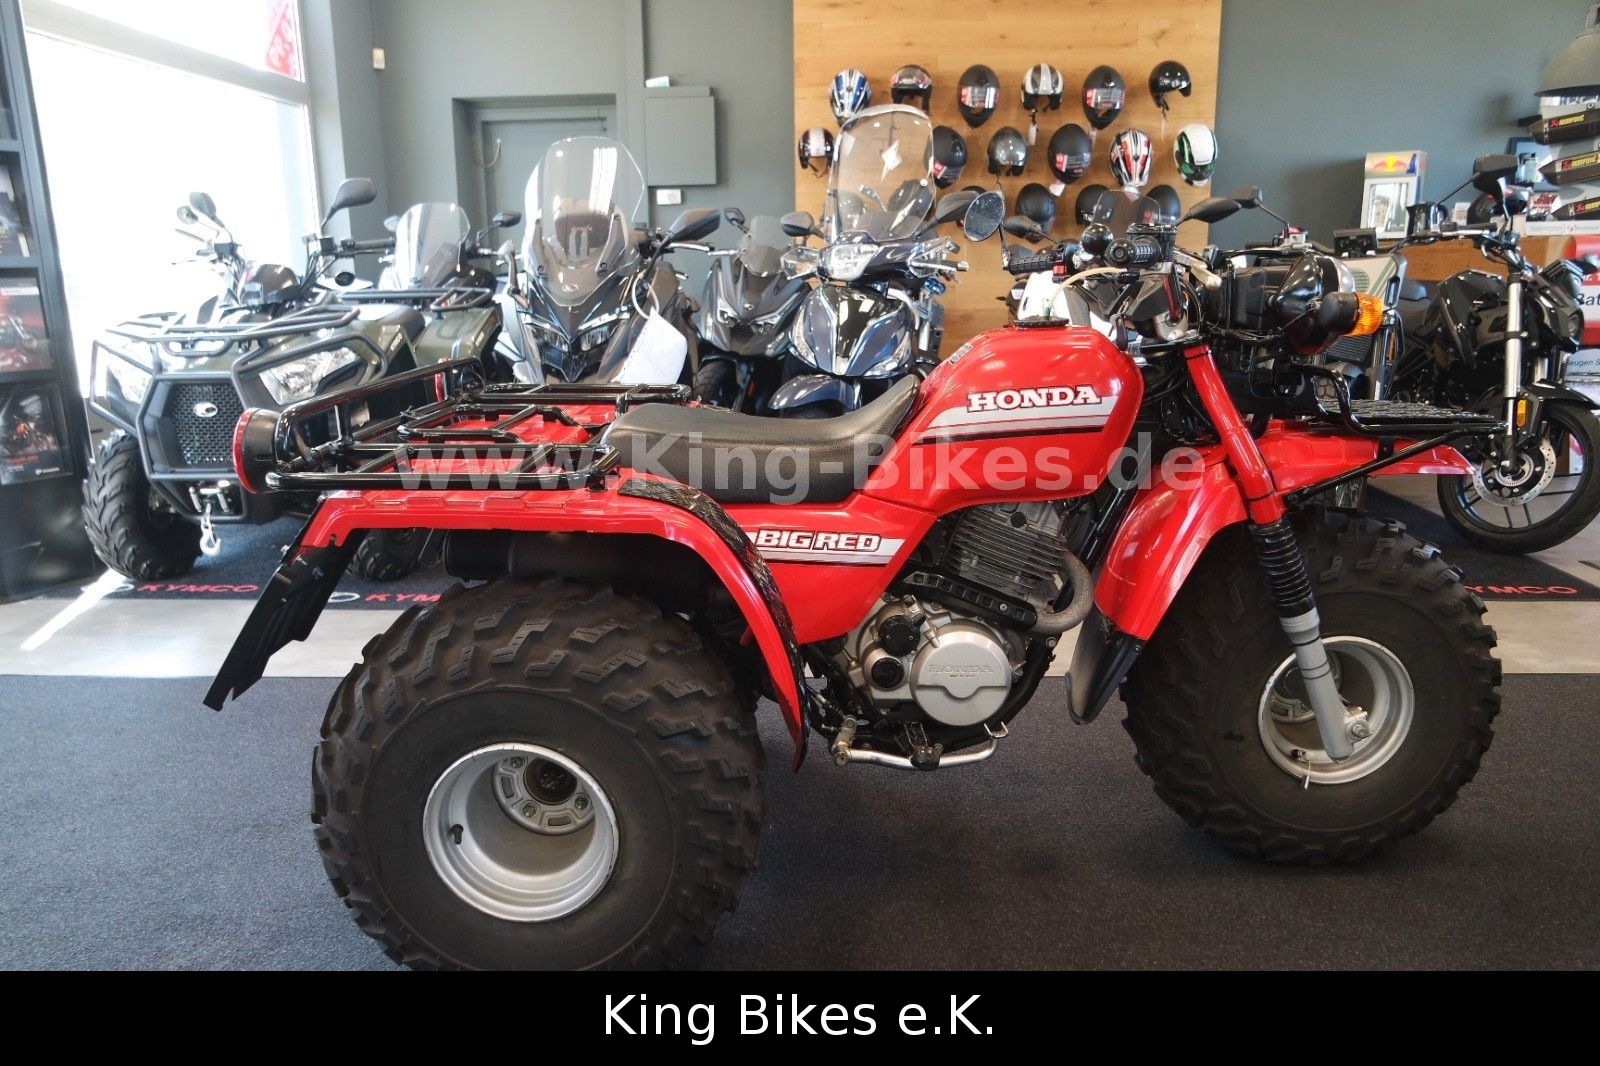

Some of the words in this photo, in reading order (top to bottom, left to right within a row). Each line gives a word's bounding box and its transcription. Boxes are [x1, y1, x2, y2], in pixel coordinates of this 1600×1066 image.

[967, 384, 1102, 413] HONDA
[756, 528, 815, 550] BIG
[812, 531, 882, 552] RED
[137, 584, 258, 593] KYMCO
[1463, 585, 1578, 594] YMCO
[364, 593, 442, 602] KYM
